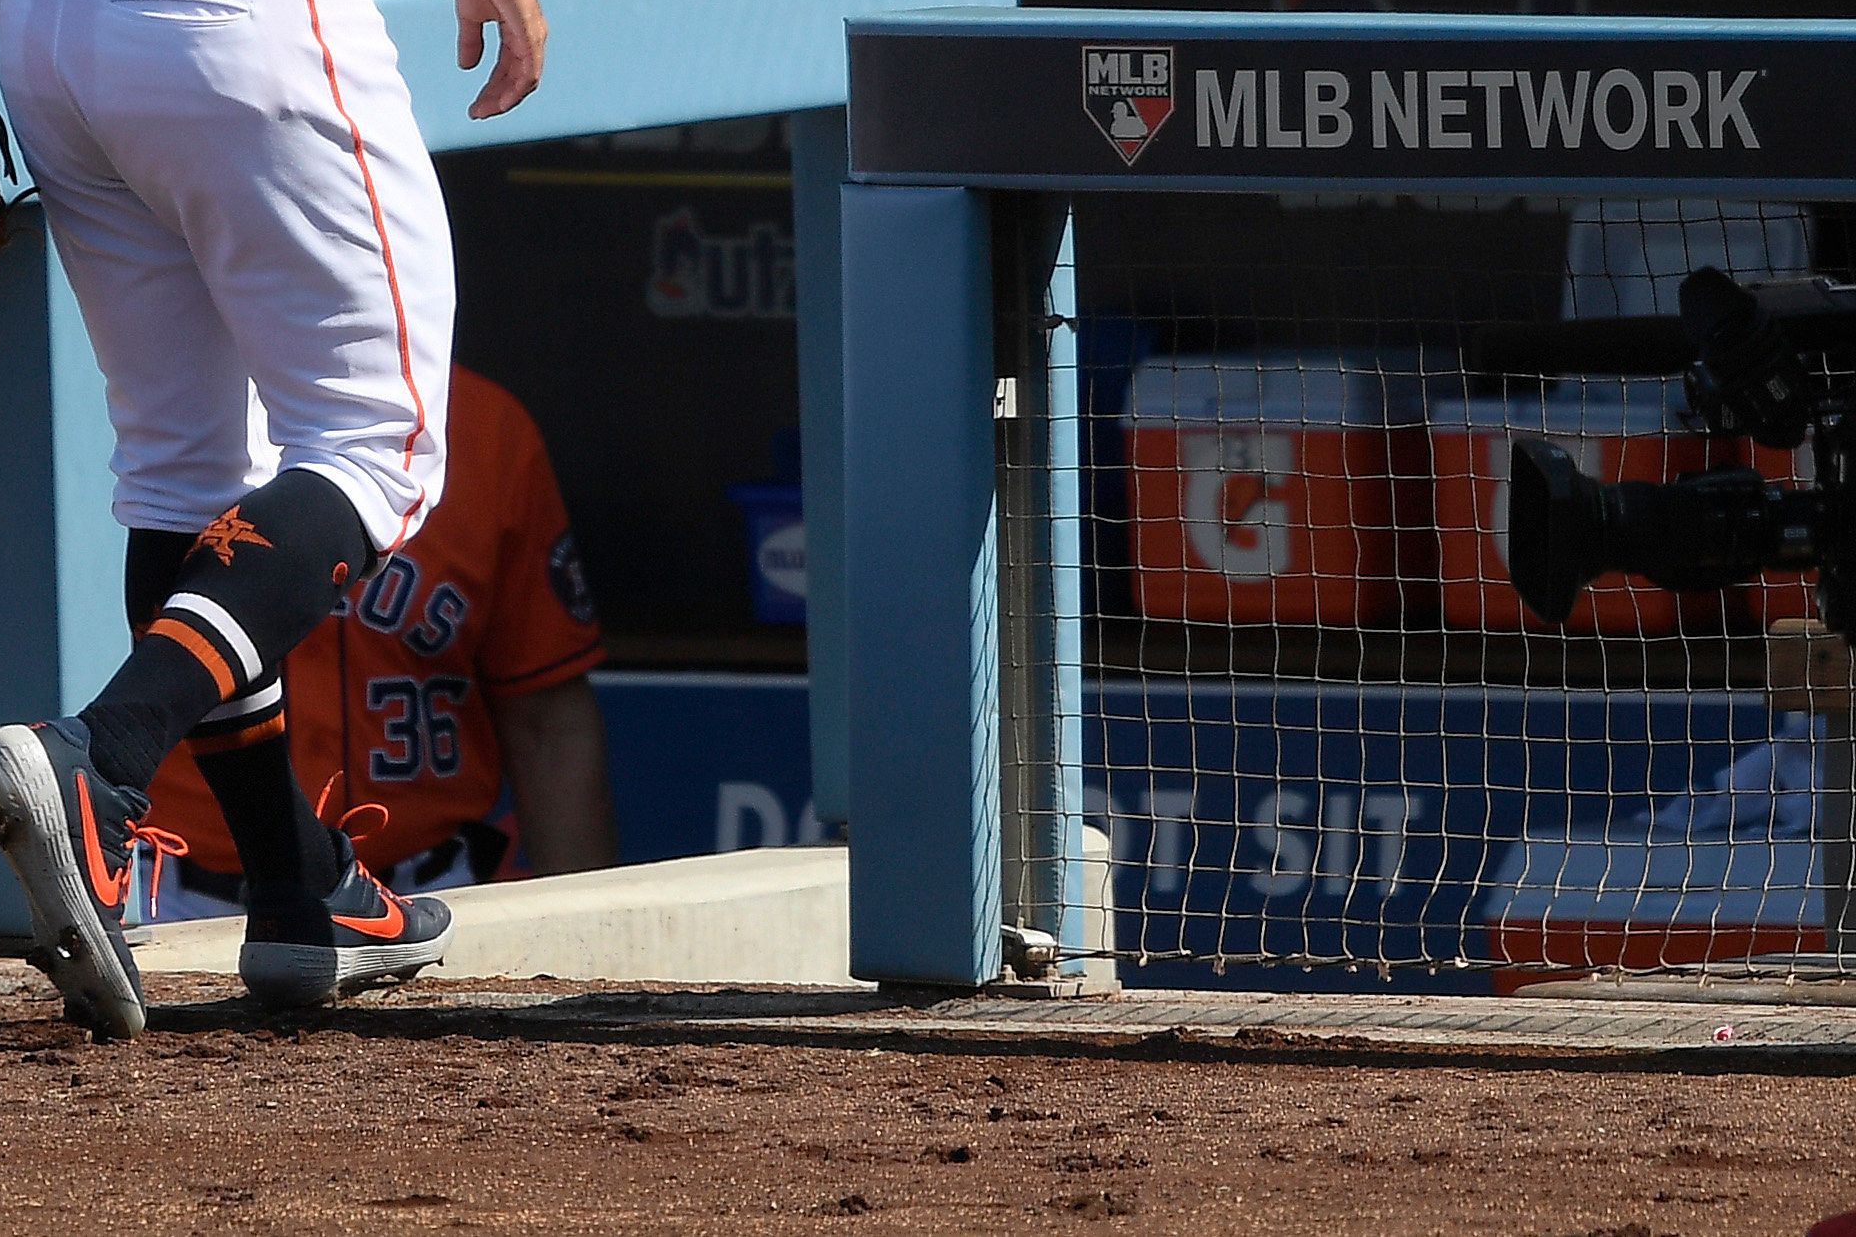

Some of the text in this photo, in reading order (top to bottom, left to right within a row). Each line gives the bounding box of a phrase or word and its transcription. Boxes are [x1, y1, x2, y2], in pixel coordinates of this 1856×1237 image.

[1087, 52, 1169, 84] MLB
[1087, 85, 1169, 97] NETWORK
[1195, 67, 1762, 152] MLB NETWORK
[331, 552, 472, 656] OS
[366, 673, 472, 782] 36
[1249, 788, 1425, 898] SIT
